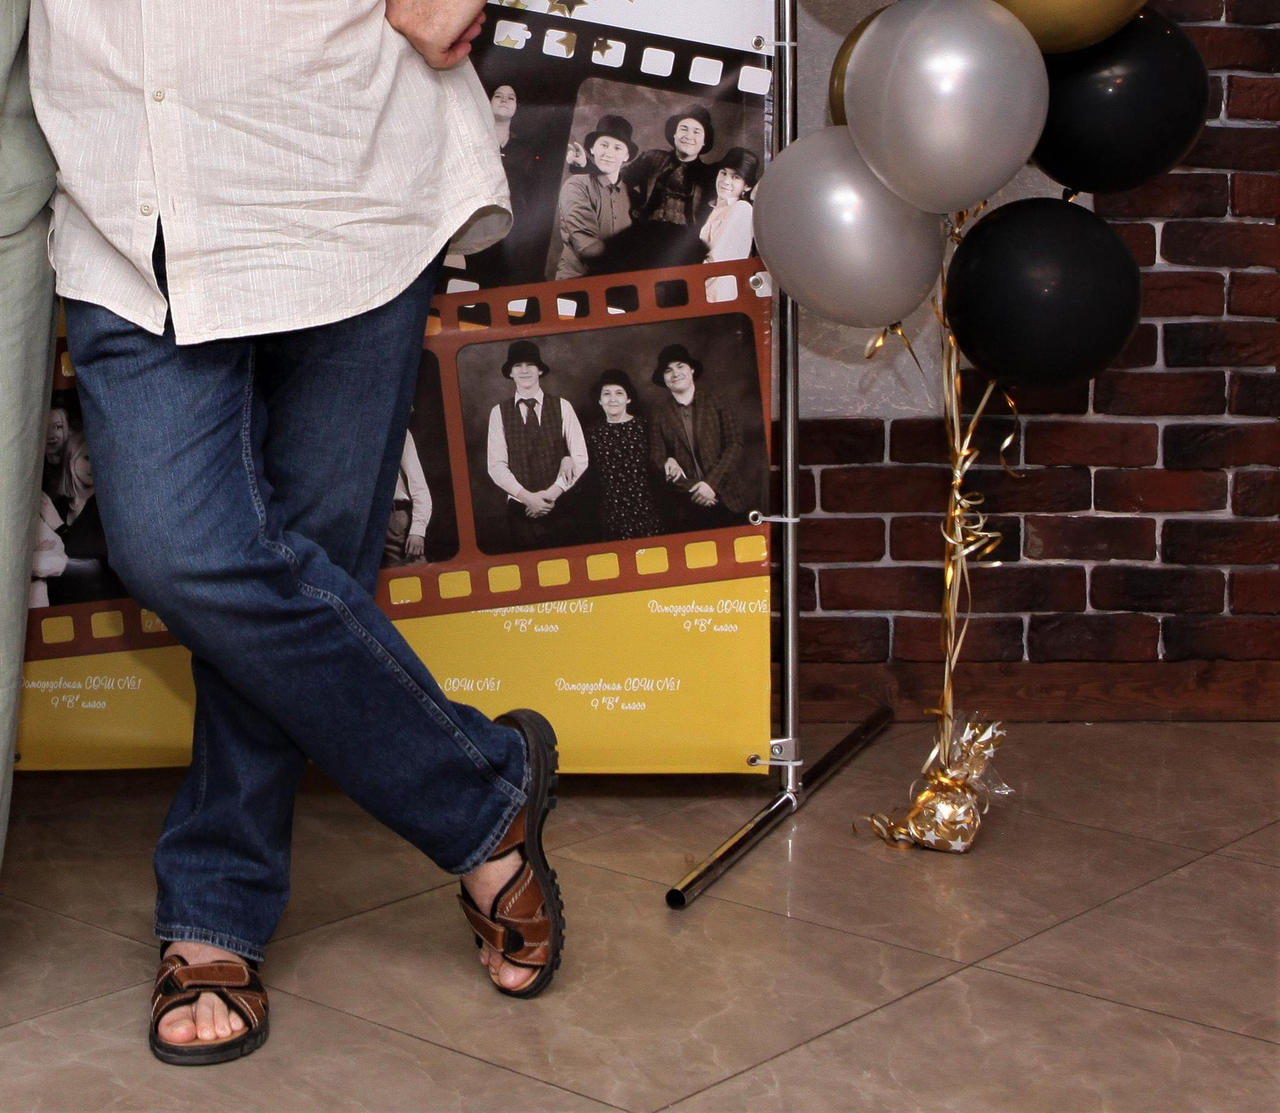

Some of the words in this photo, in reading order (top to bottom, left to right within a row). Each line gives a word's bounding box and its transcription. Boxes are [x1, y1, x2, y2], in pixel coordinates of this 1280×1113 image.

[537, 599, 567, 613] СОШ
[716, 598, 747, 615] СОШ
[504, 621, 512, 633] 9
[683, 620, 692, 632] 9
[84, 675, 115, 690] СОШ
[443, 677, 475, 692] СОШ
[623, 676, 656, 692] СОШ
[50, 695, 59, 708] 9
[590, 697, 599, 710] 9
